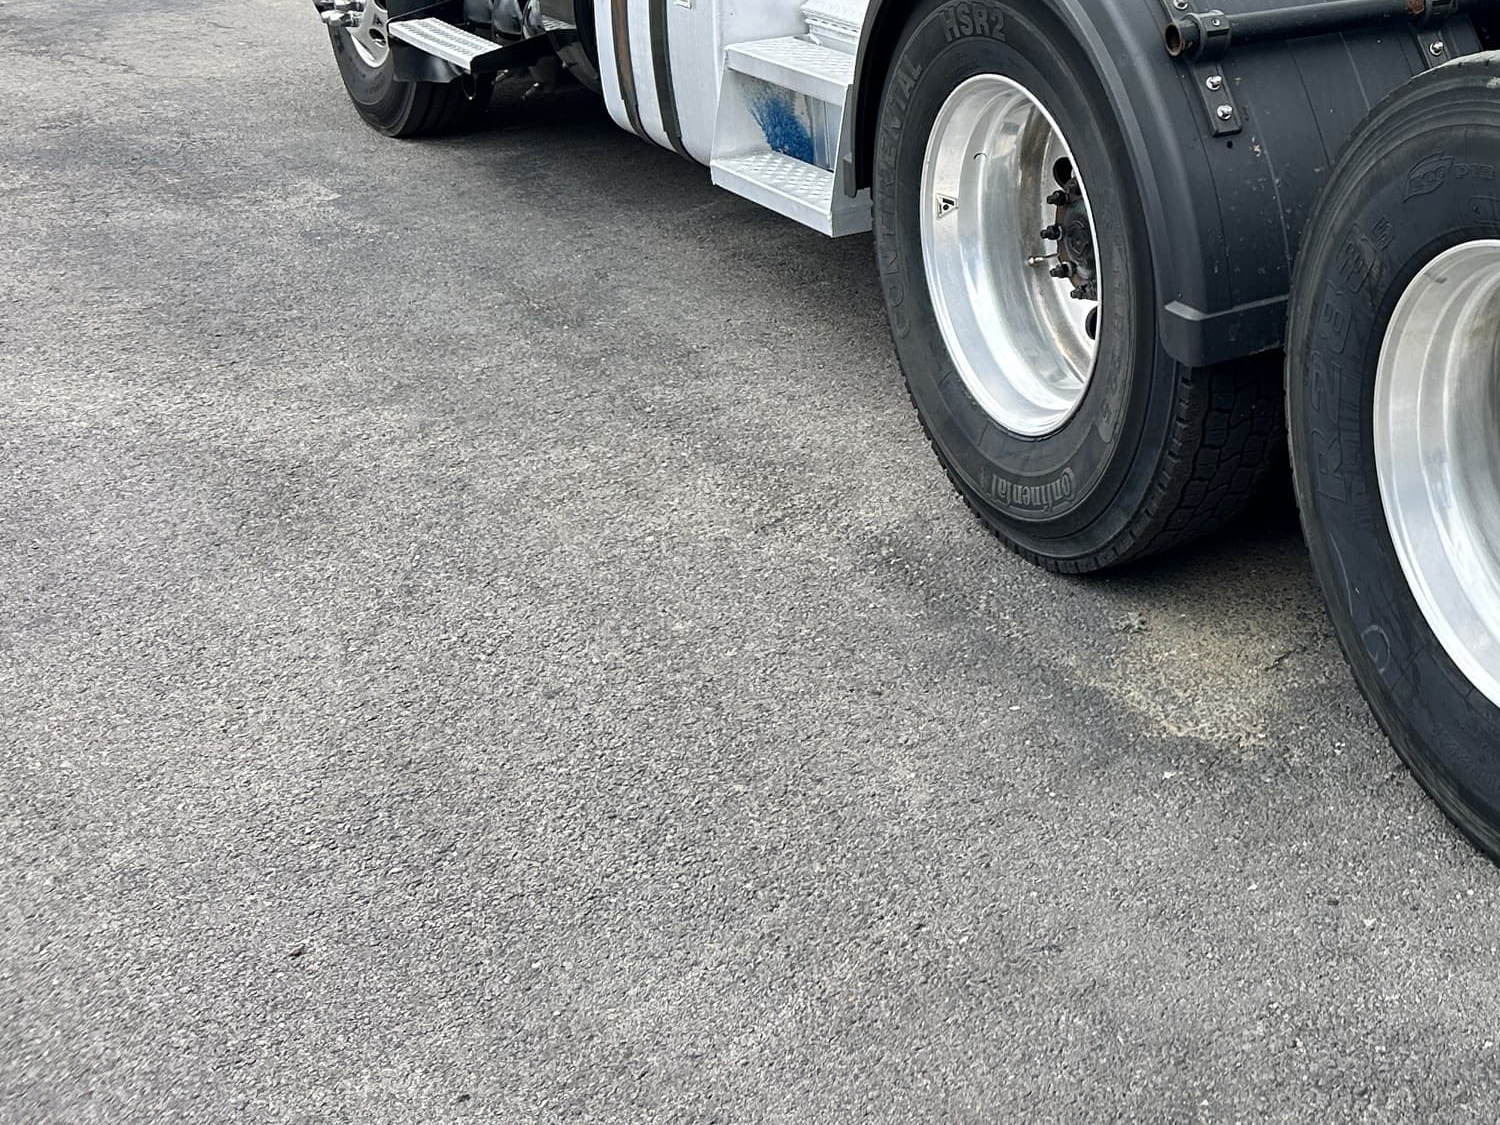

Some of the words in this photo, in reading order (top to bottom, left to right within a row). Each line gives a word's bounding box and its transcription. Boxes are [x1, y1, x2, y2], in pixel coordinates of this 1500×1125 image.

[939, 0, 1009, 45] HSR2
[876, 59, 924, 342] CONTINENTAL
[991, 466, 1078, 514] Continental
